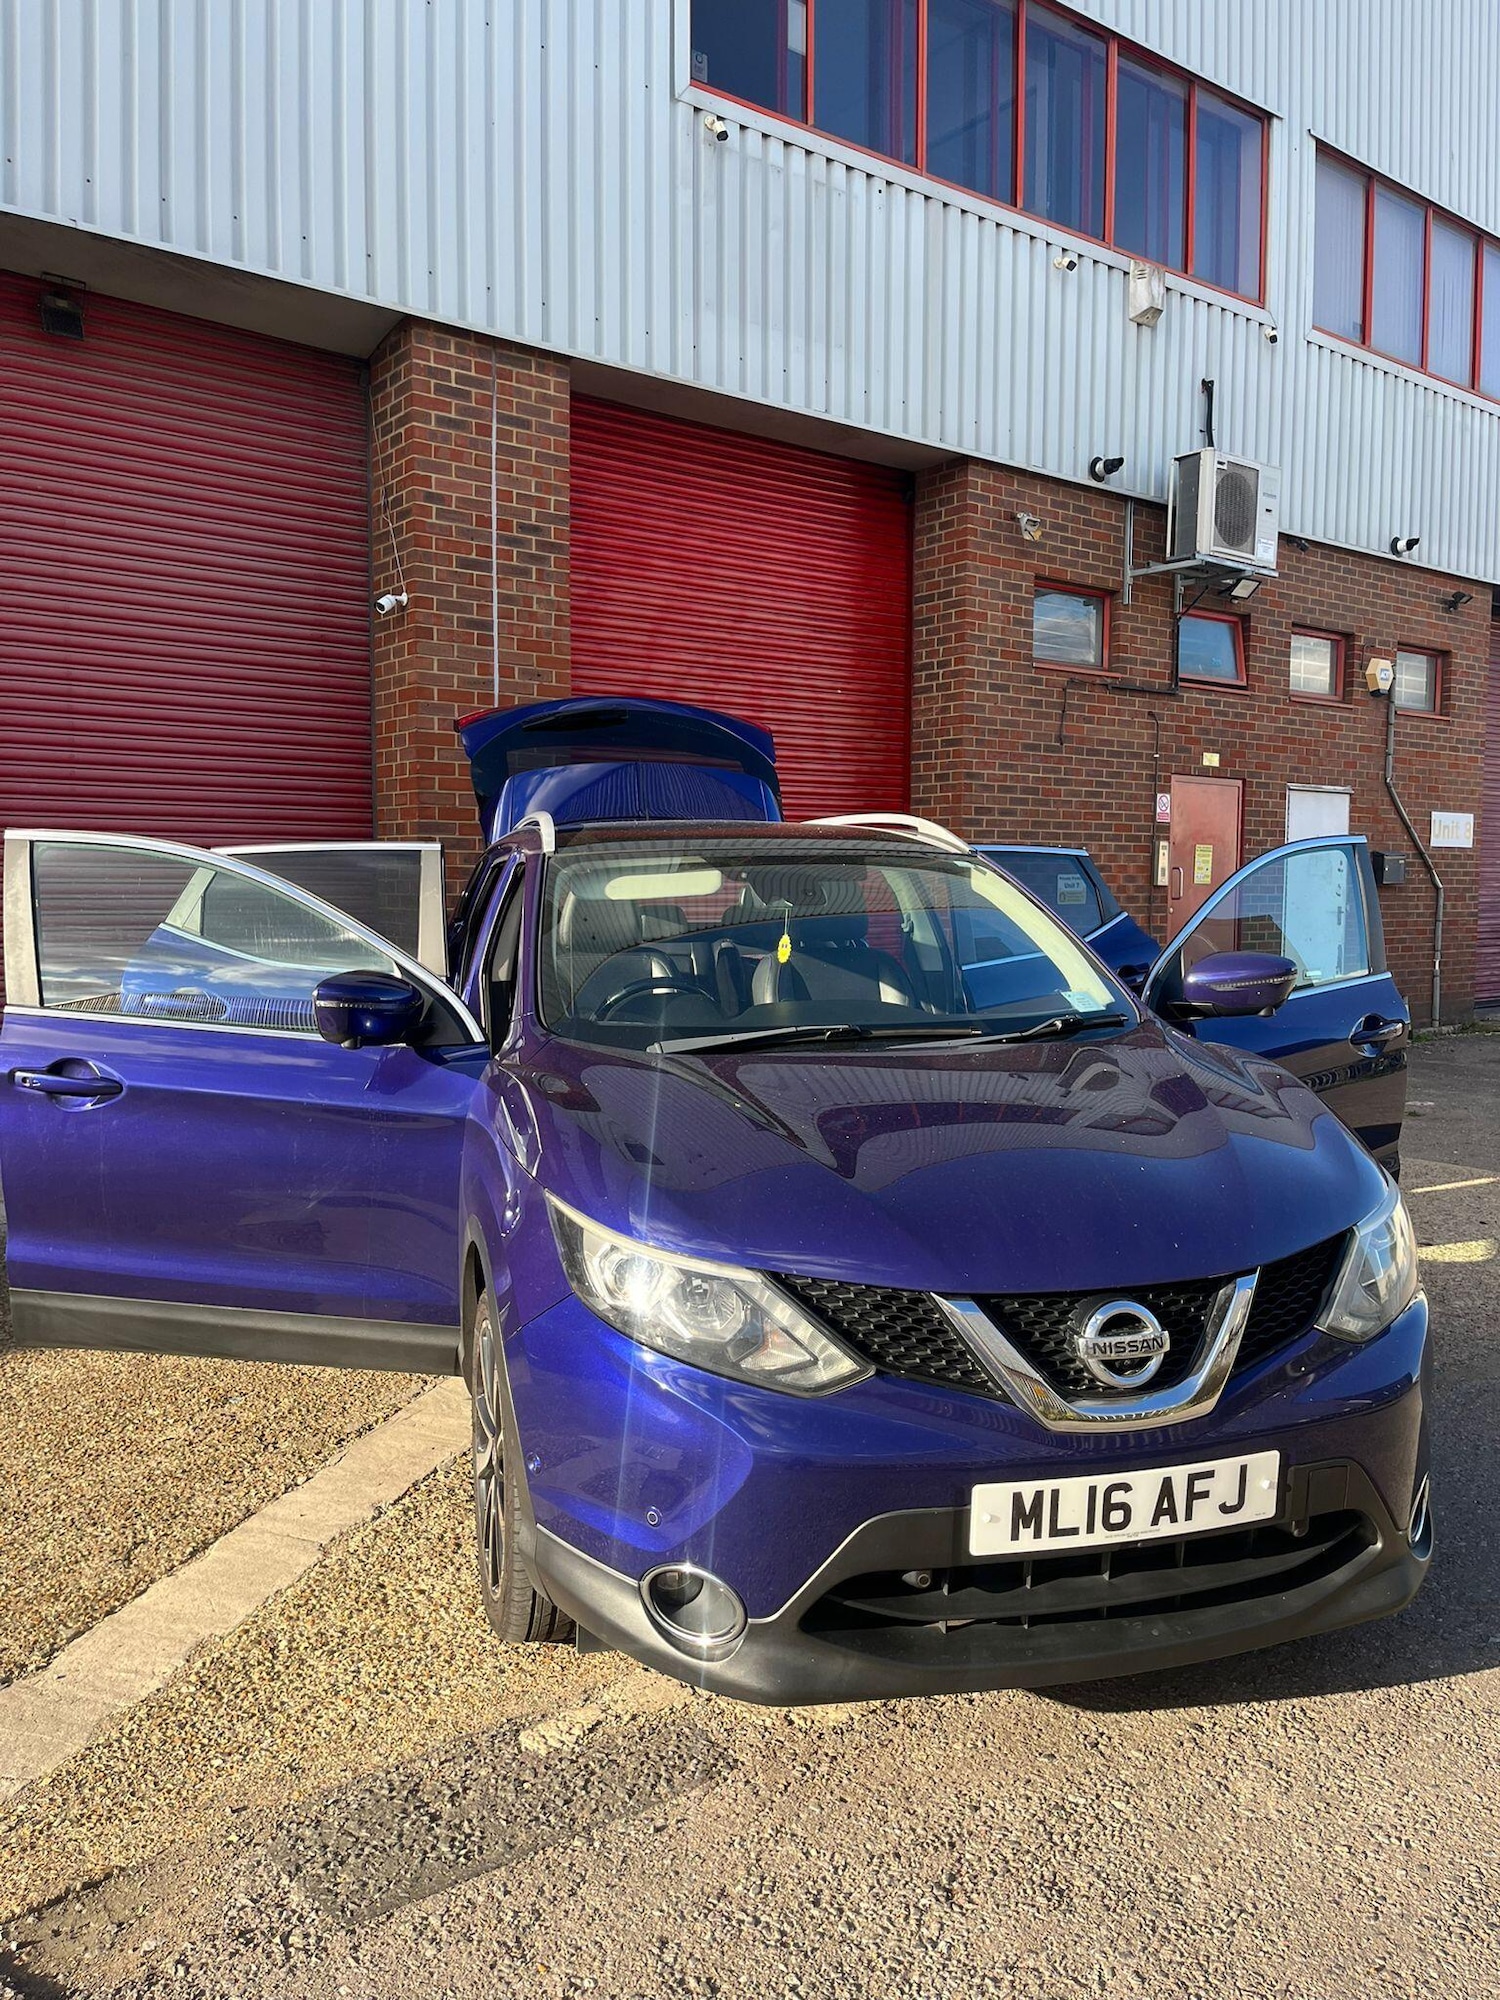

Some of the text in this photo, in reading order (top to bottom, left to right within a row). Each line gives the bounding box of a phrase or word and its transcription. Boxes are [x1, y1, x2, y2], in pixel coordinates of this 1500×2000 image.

[1433, 819, 1459, 839] Unit
[1092, 1336, 1164, 1355] NISSAN
[1010, 1463, 1248, 1542] ML16 AFJ
